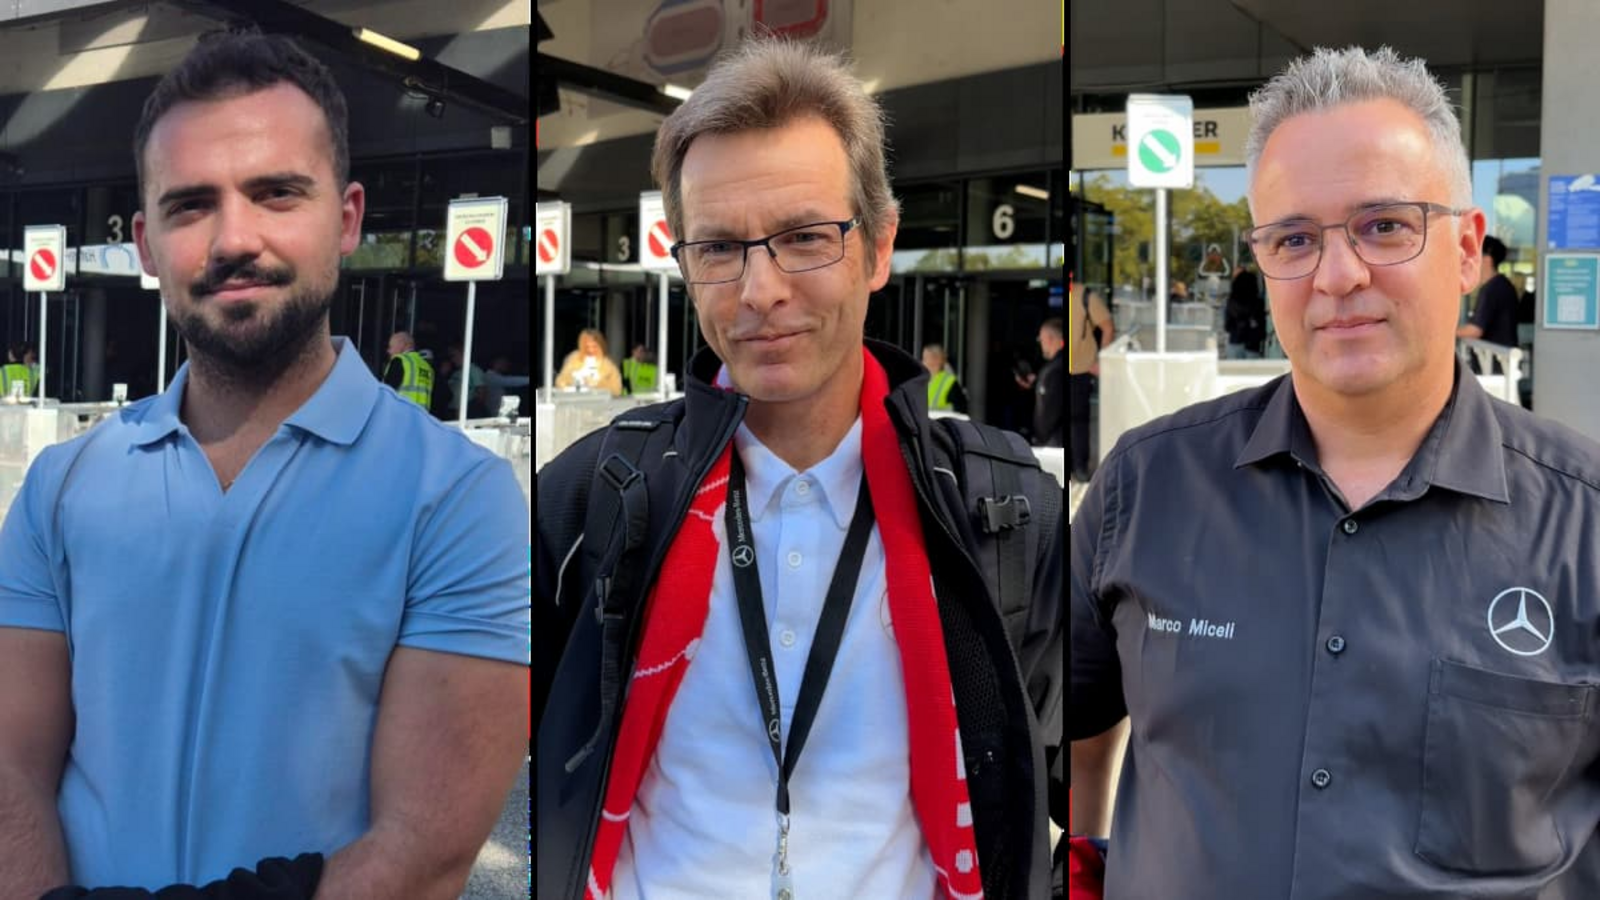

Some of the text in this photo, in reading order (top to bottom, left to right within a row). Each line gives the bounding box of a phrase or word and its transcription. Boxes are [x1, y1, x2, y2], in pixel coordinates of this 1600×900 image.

[107, 214, 123, 244] 3
[993, 204, 1014, 240] 6
[618, 235, 630, 261] 3
[1188, 618, 1236, 640] Miceli
